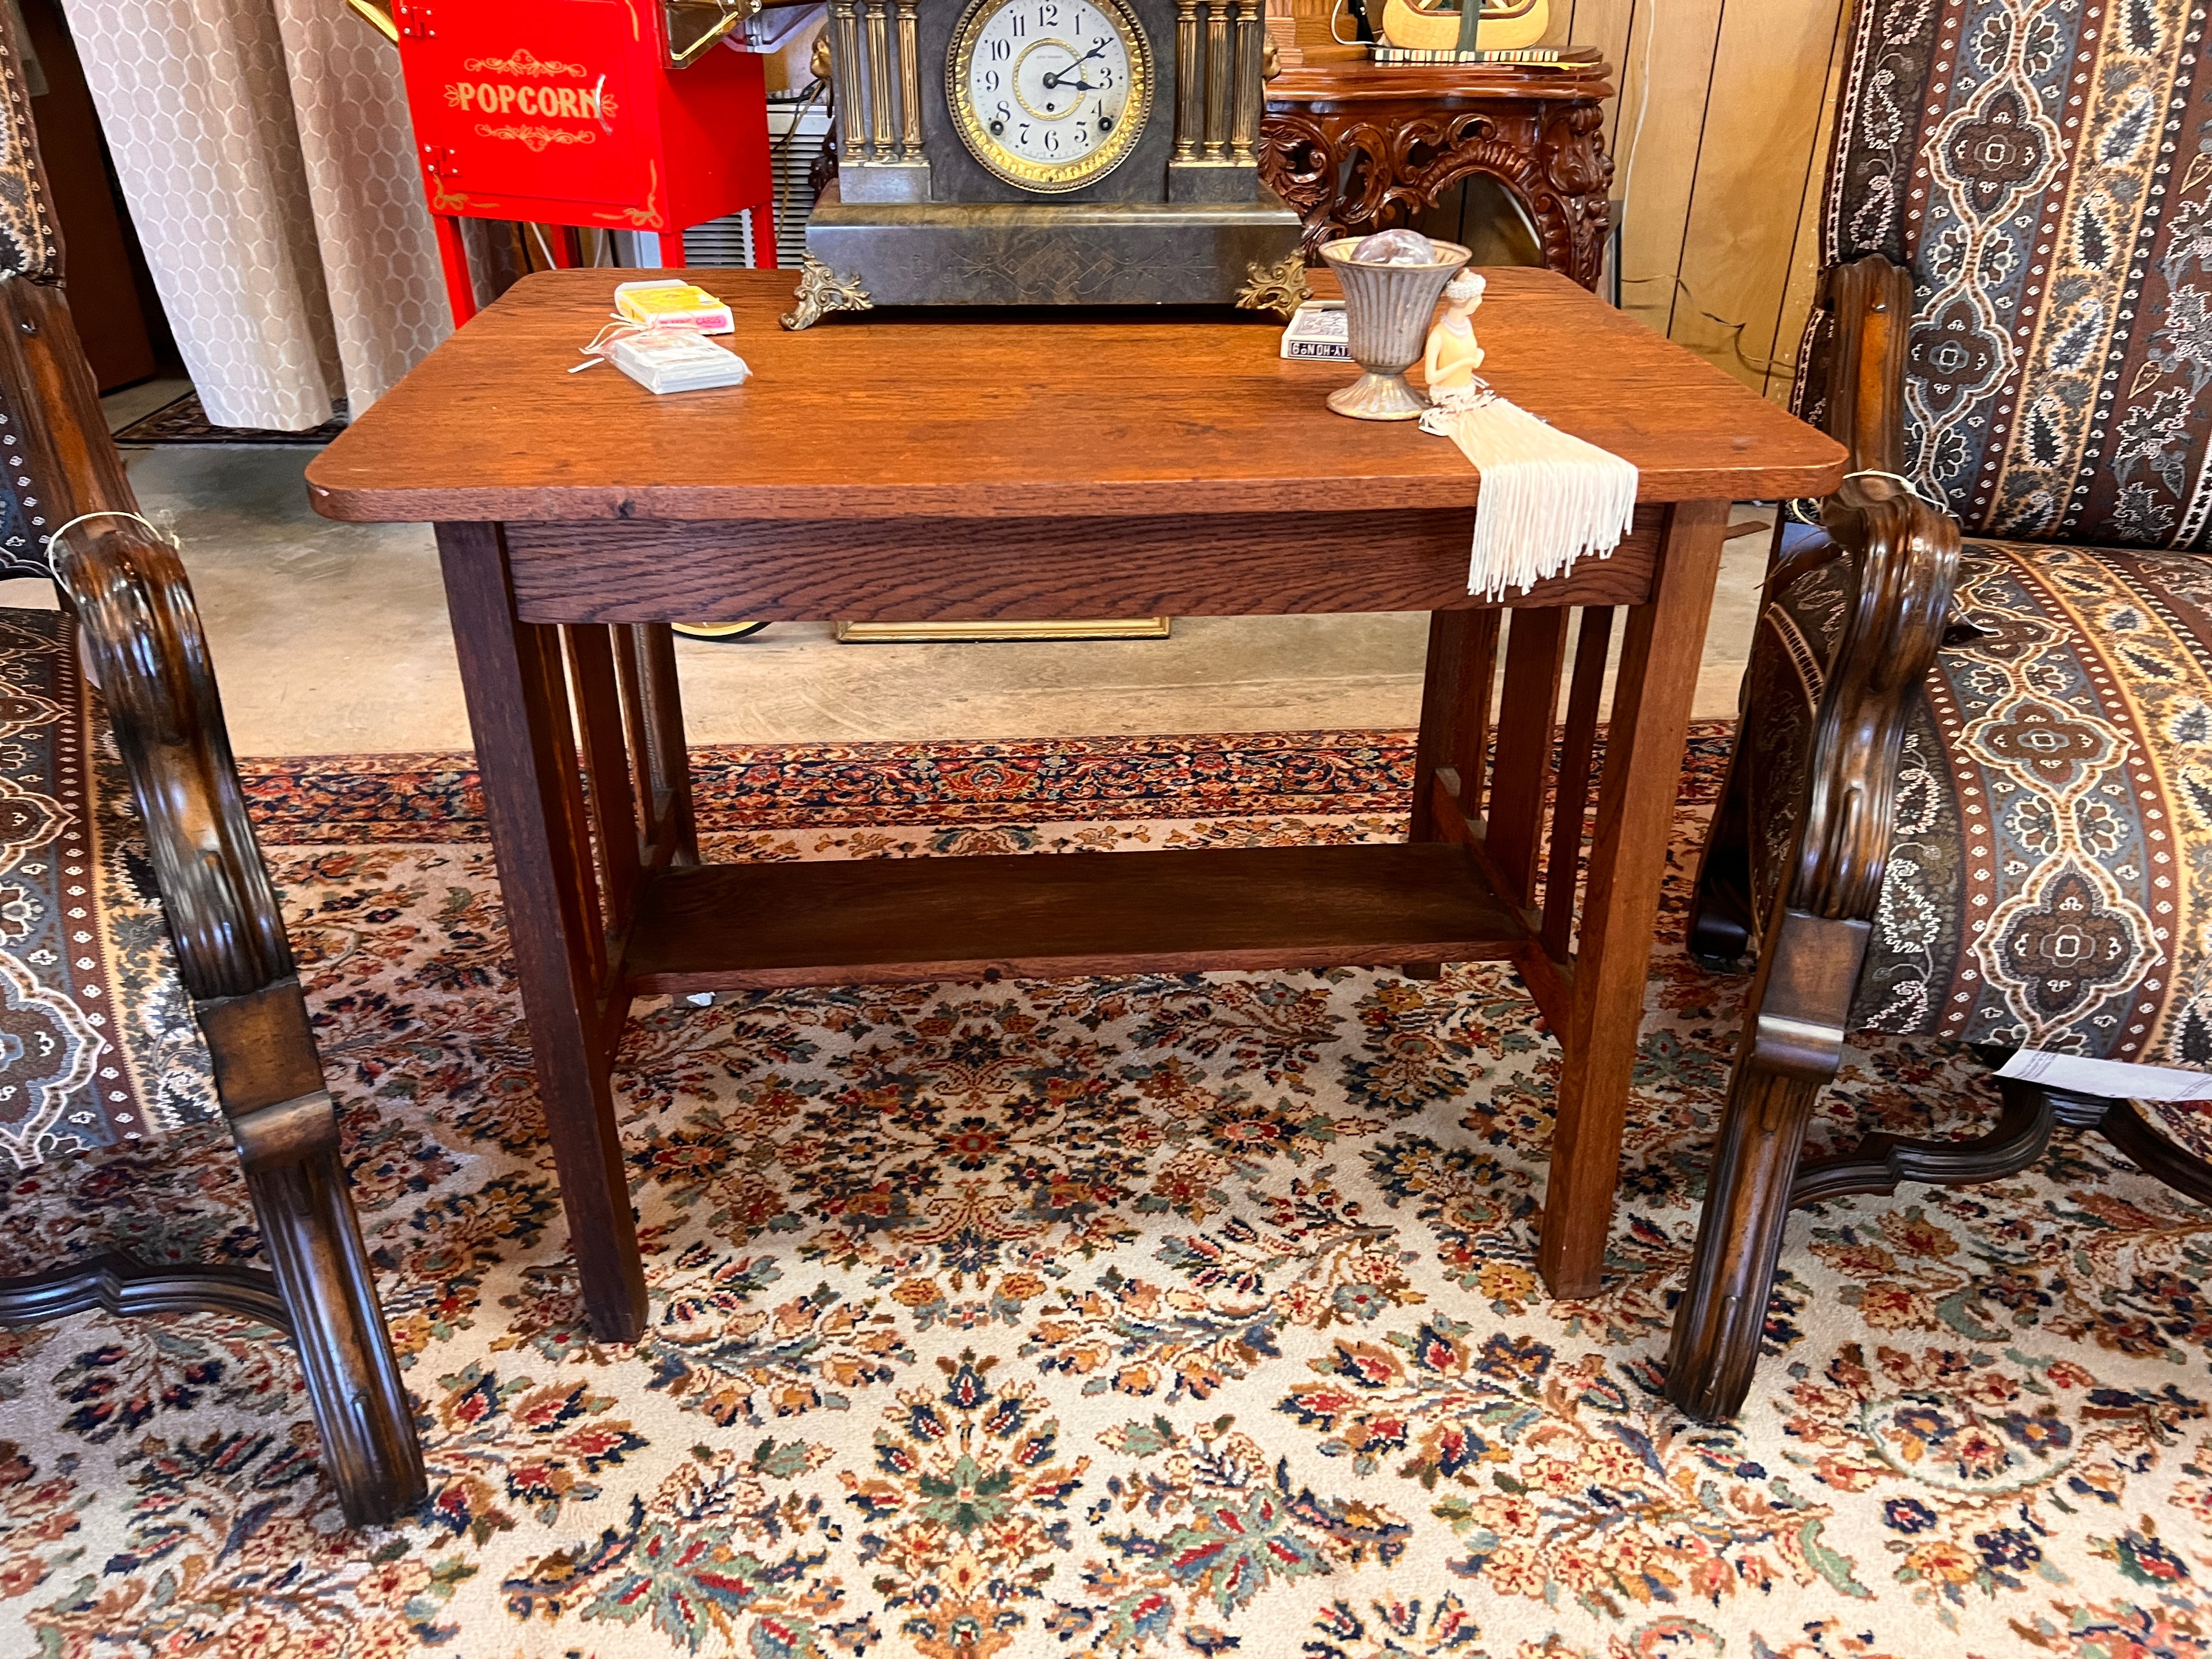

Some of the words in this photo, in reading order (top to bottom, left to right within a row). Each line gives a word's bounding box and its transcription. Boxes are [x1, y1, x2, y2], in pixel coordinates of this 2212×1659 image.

[1012, 14, 1025, 36] 11
[1039, 5, 1058, 27] 12
[1075, 14, 1080, 35] 1
[991, 39, 1010, 60] 10
[1093, 37, 1105, 58] 2
[986, 70, 999, 92] 9
[1100, 67, 1112, 89] 3
[456, 82, 600, 119] POPCORN
[1091, 98, 1102, 118] 4
[997, 101, 1010, 122] 8
[1020, 123, 1030, 144] 7
[1045, 130, 1058, 151] 6
[1075, 122, 1087, 142] 5
